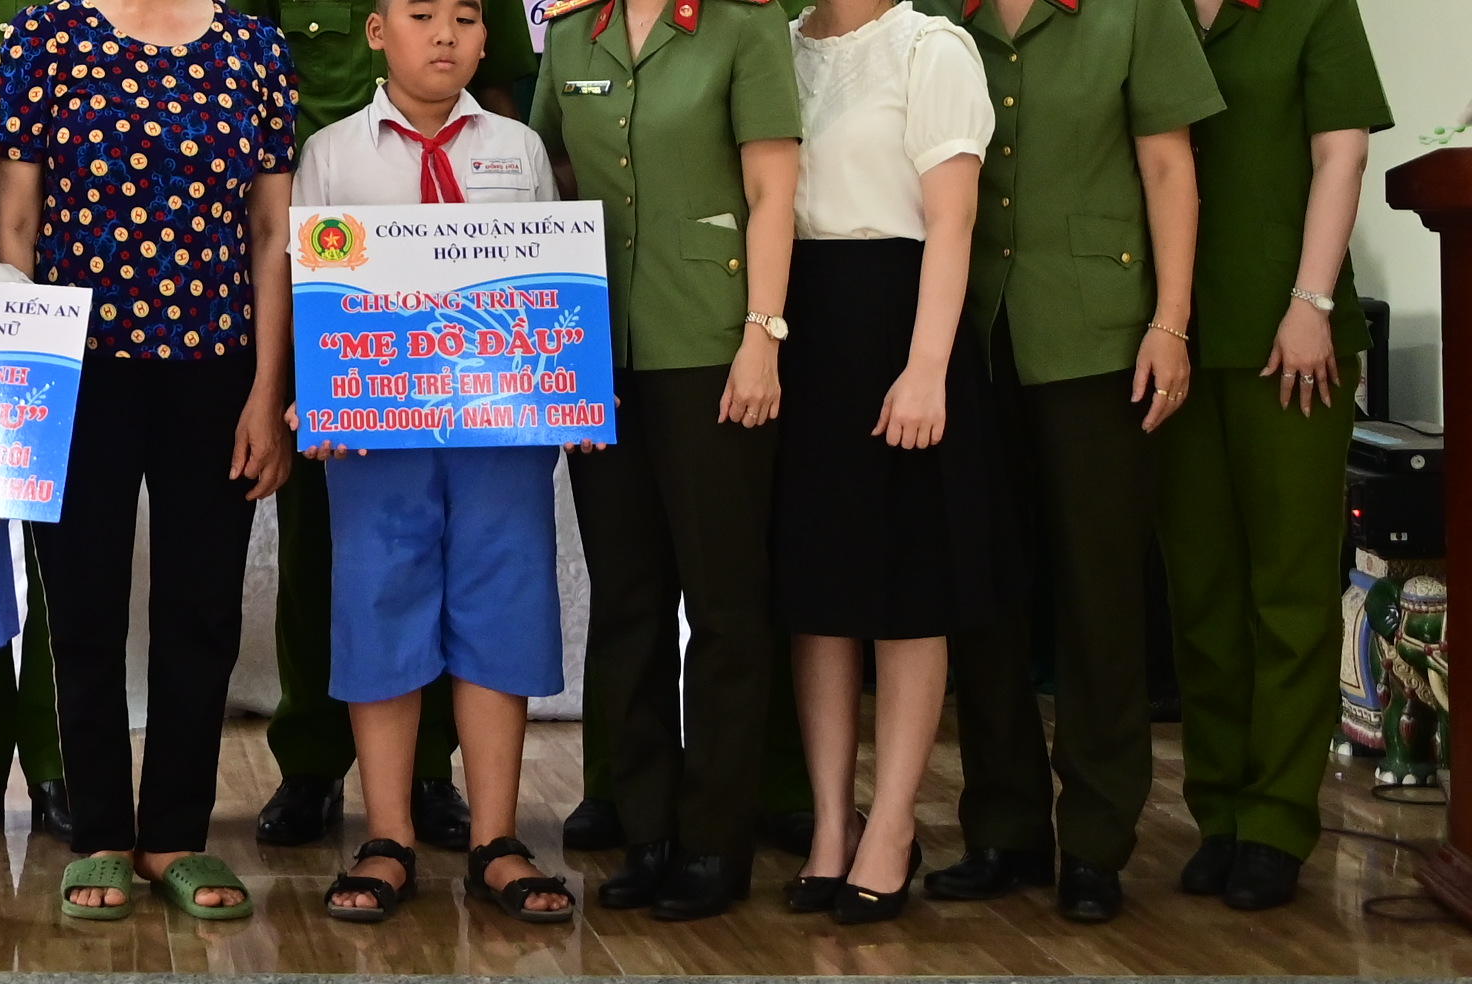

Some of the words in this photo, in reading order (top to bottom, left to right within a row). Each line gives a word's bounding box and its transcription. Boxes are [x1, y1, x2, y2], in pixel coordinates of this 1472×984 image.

[375, 221, 428, 238] CÔNG
[433, 223, 459, 237] AN
[463, 219, 516, 240] QUẬN
[521, 215, 566, 235] KIẾN
[570, 219, 596, 234] AN
[433, 244, 468, 263] HỘI
[472, 245, 510, 262] PHỤ
[514, 242, 541, 259] NỮ
[4, 296, 50, 316] KIẾN
[54, 304, 81, 318] AN
[341, 288, 463, 313] CHƯƠNG
[468, 285, 559, 310] TRÌNH
[319, 330, 398, 366] “MẸ
[407, 322, 466, 358] ĐỠ
[476, 315, 584, 357] ĐẦU”
[332, 368, 363, 398] HỖ
[366, 372, 409, 400] TRỢ
[414, 366, 453, 396] TRẺ
[459, 372, 492, 395] EM
[540, 366, 576, 394] CÔI
[307, 405, 455, 432] 12.000.000đ/1
[462, 401, 513, 429] NĂM
[518, 404, 538, 428] /1
[546, 399, 605, 427] CHÁU
